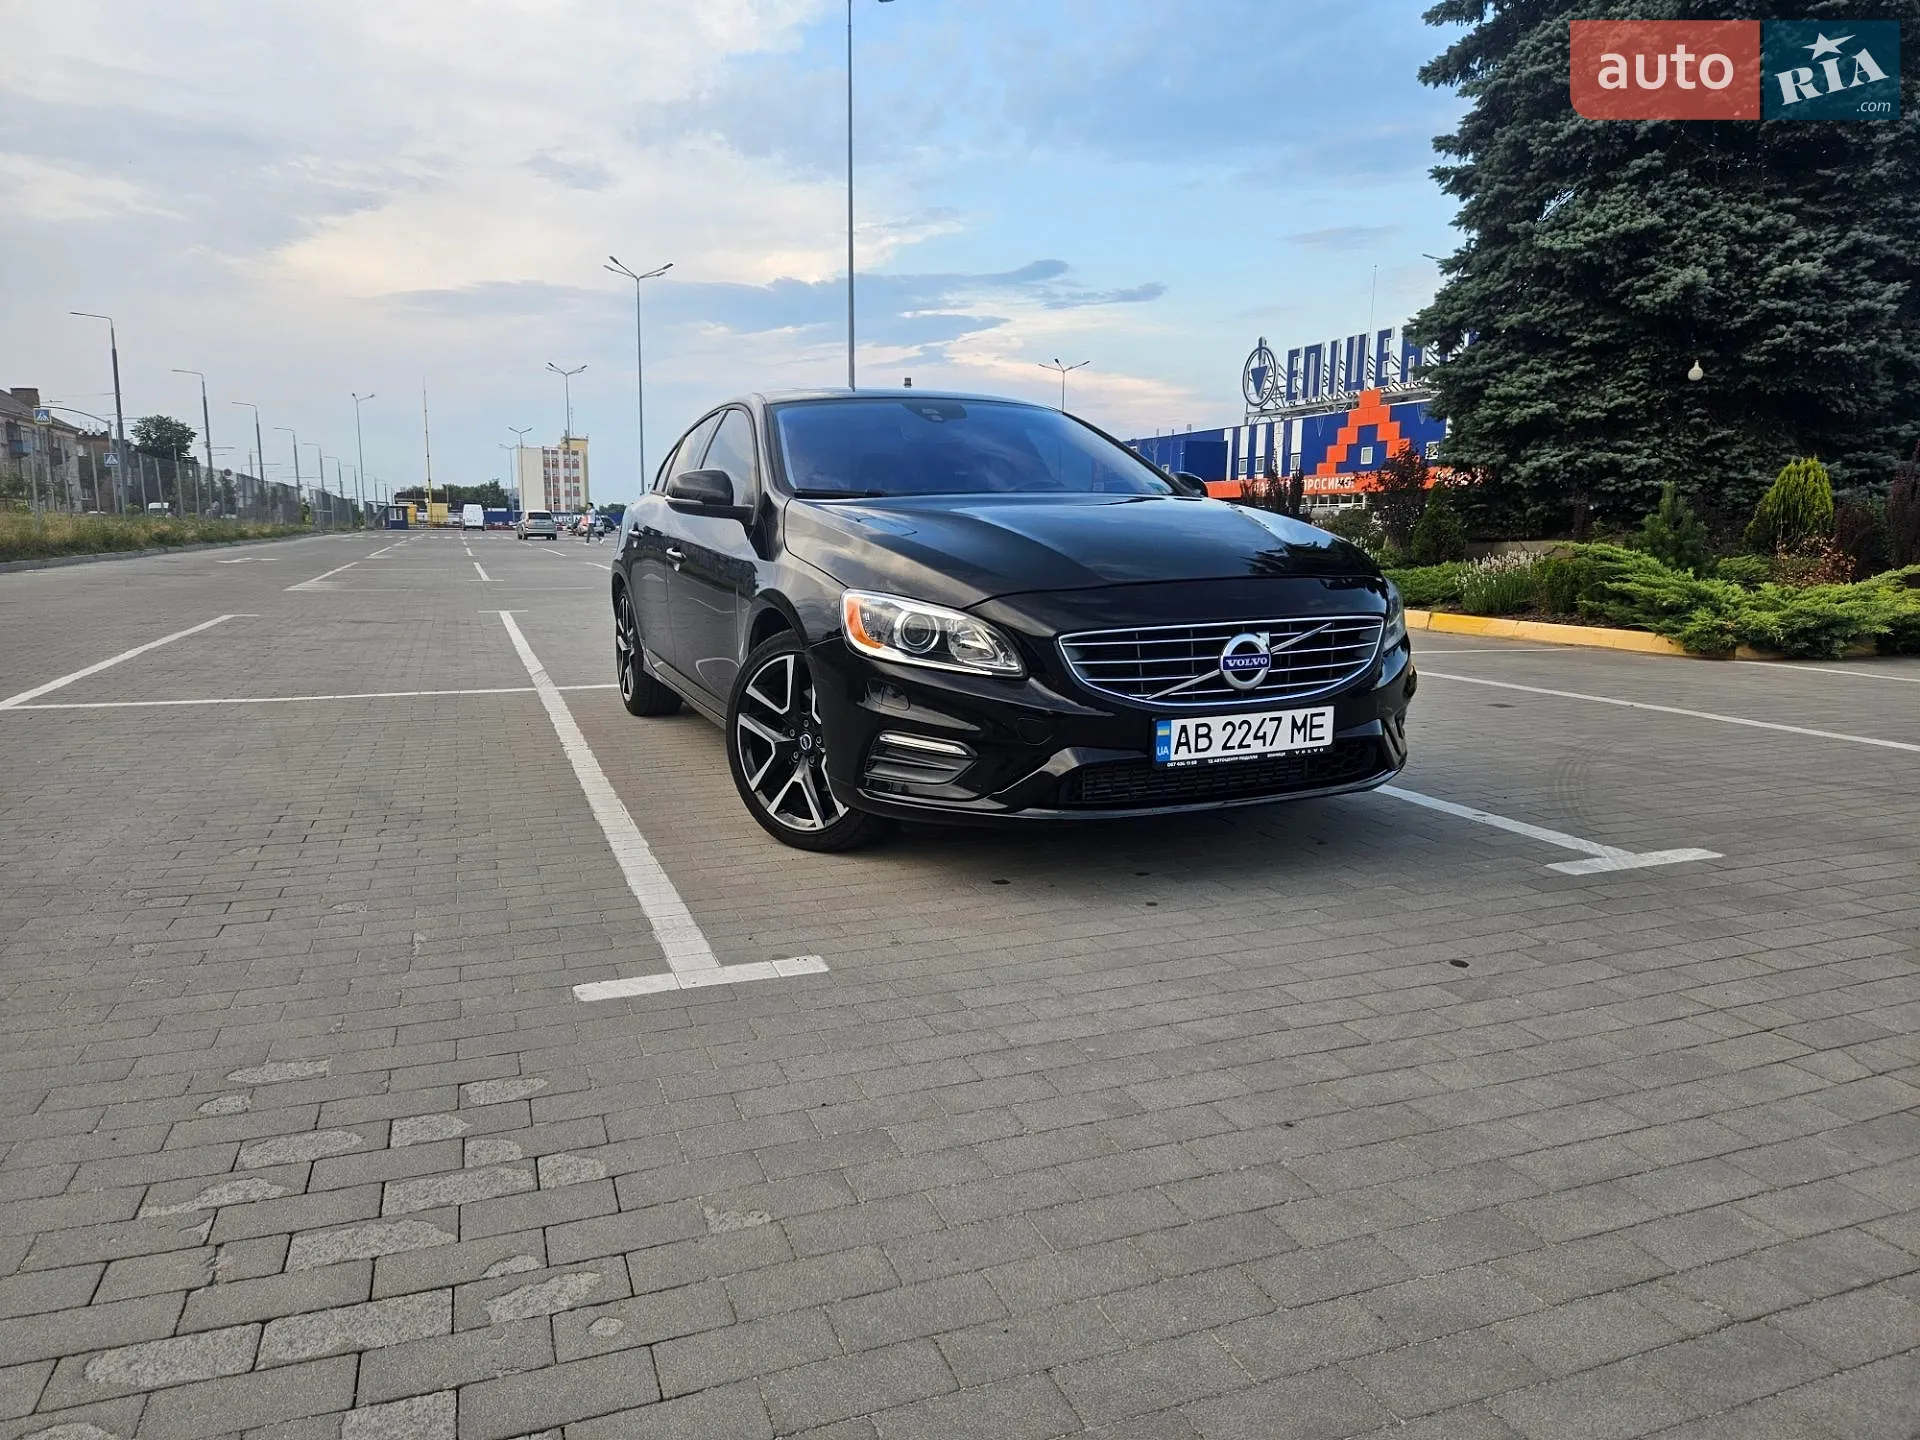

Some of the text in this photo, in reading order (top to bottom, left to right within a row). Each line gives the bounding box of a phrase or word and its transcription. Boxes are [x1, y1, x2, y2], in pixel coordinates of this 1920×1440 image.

[1285, 327, 1478, 402] ЕПІЦЕН
[1225, 657, 1268, 667] VOLVO
[1174, 712, 1326, 755] AB 2247 ME
[1156, 746, 1169, 757] UA
